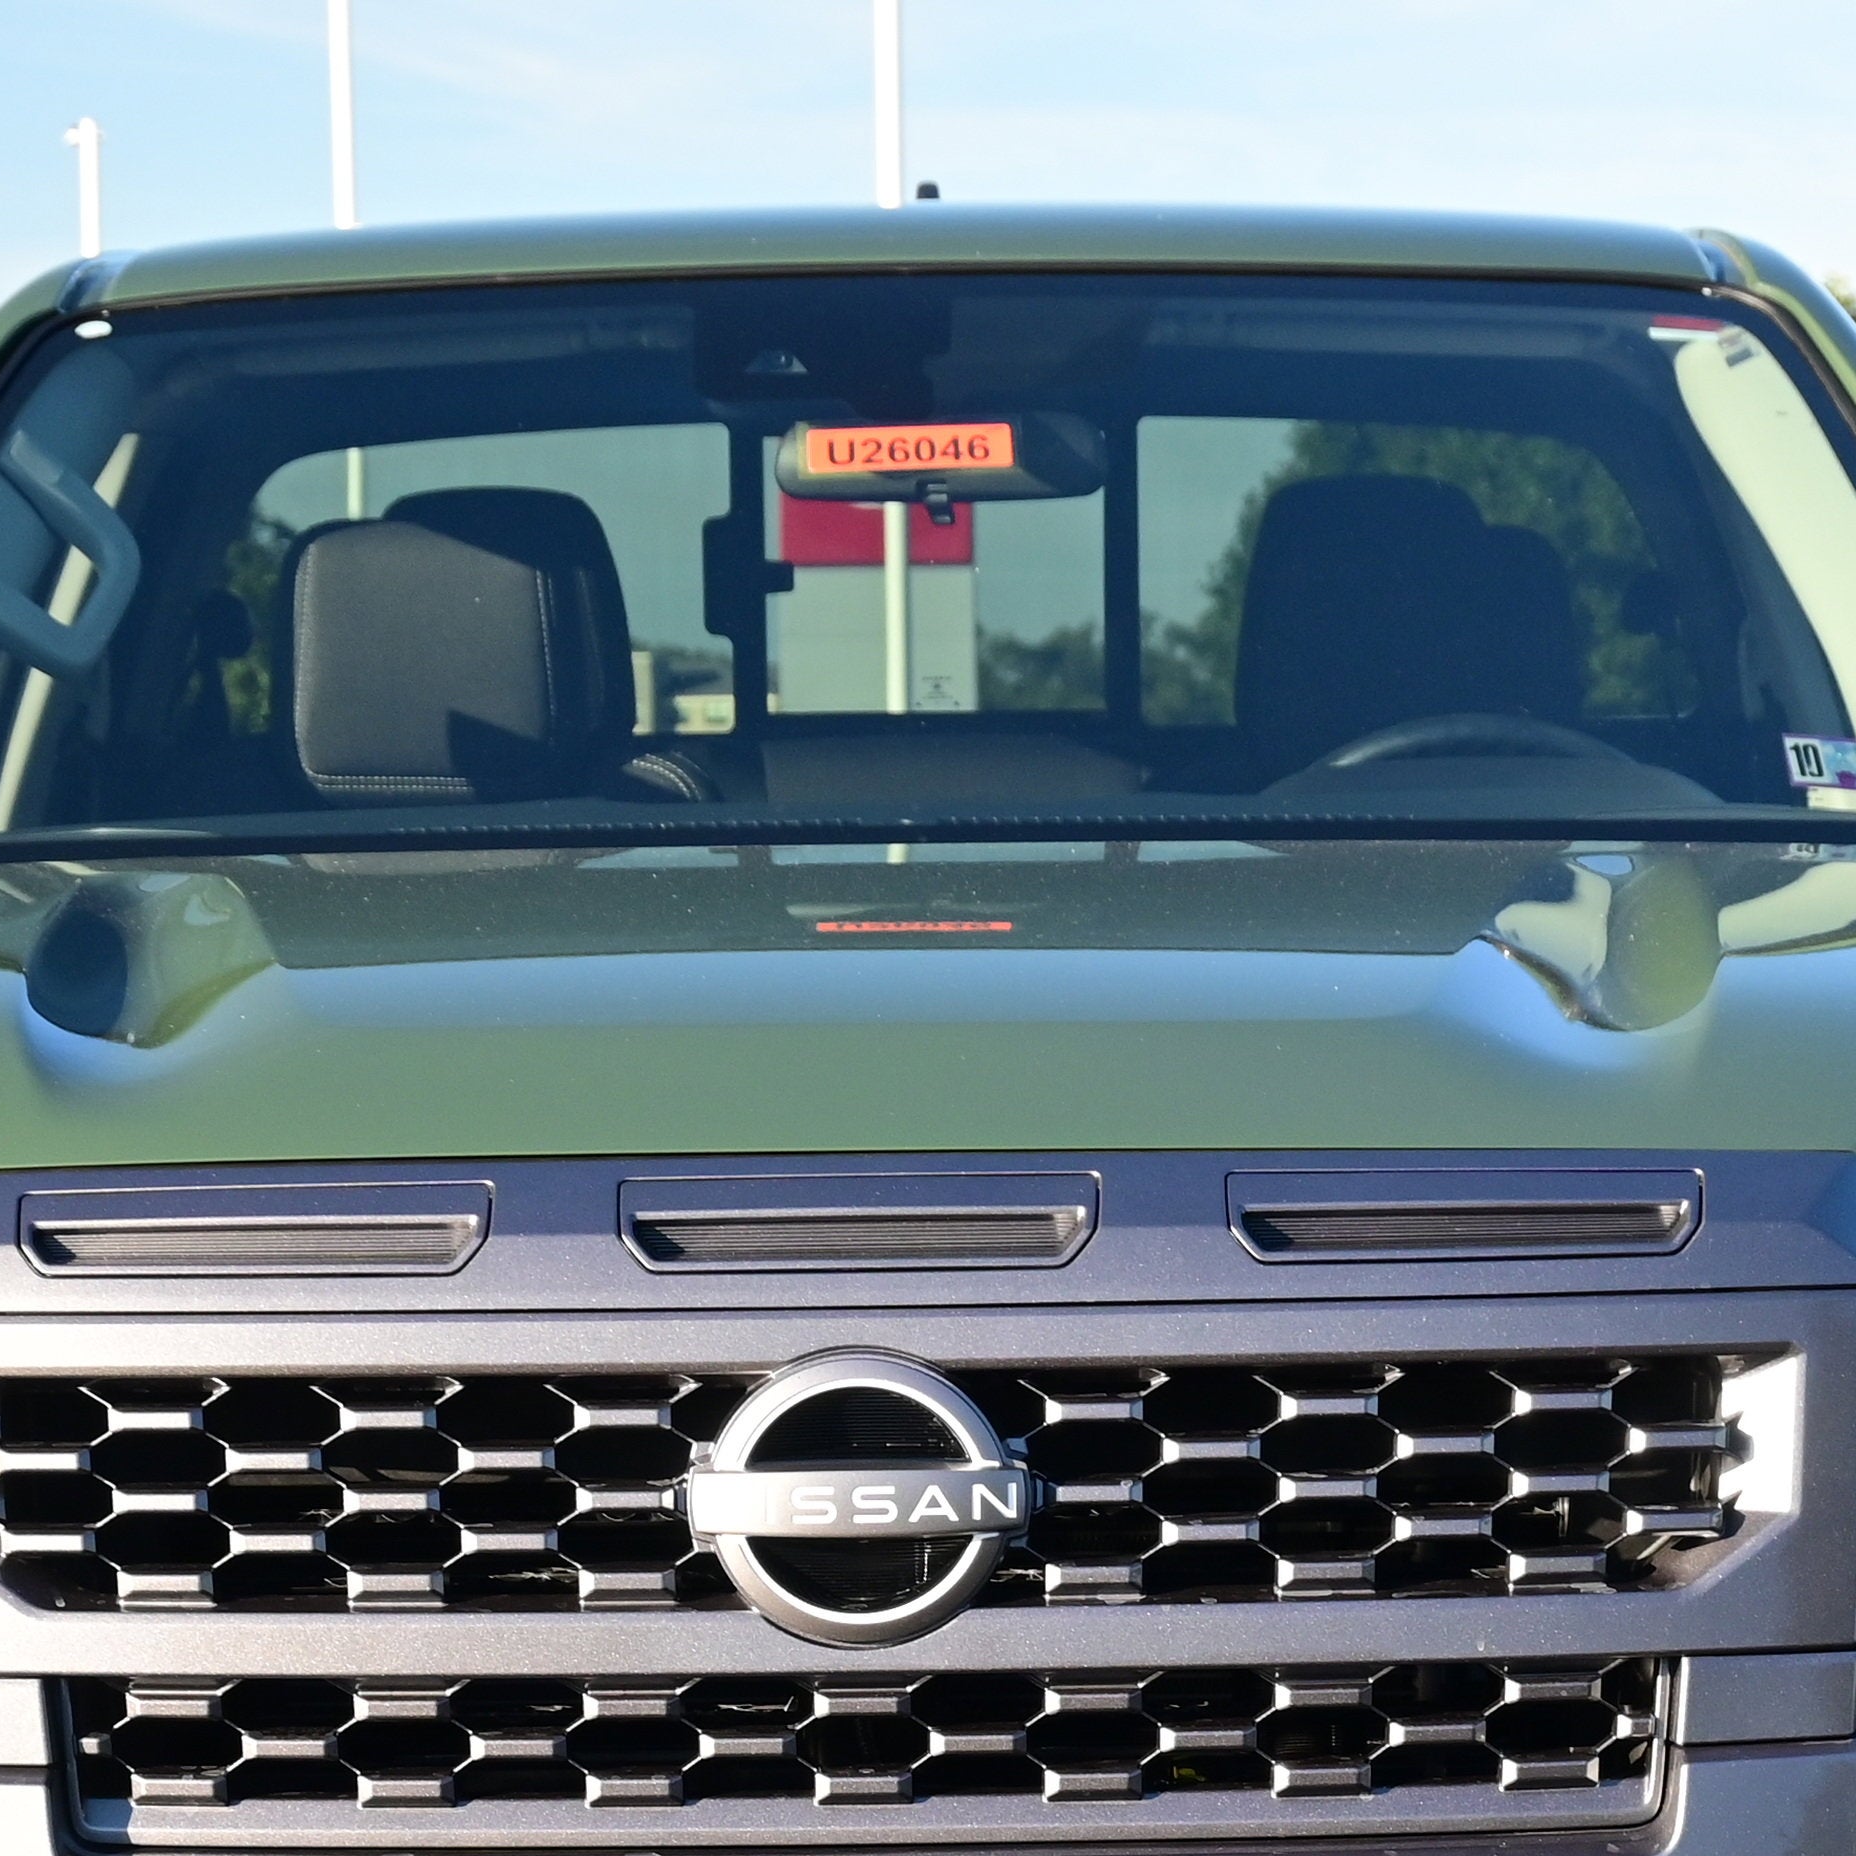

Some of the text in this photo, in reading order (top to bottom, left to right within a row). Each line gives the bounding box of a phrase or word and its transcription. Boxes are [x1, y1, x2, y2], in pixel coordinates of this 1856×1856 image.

[827, 433, 991, 466] U26046
[1789, 743, 1825, 777] 10
[700, 1481, 1018, 1525] ISSAN
